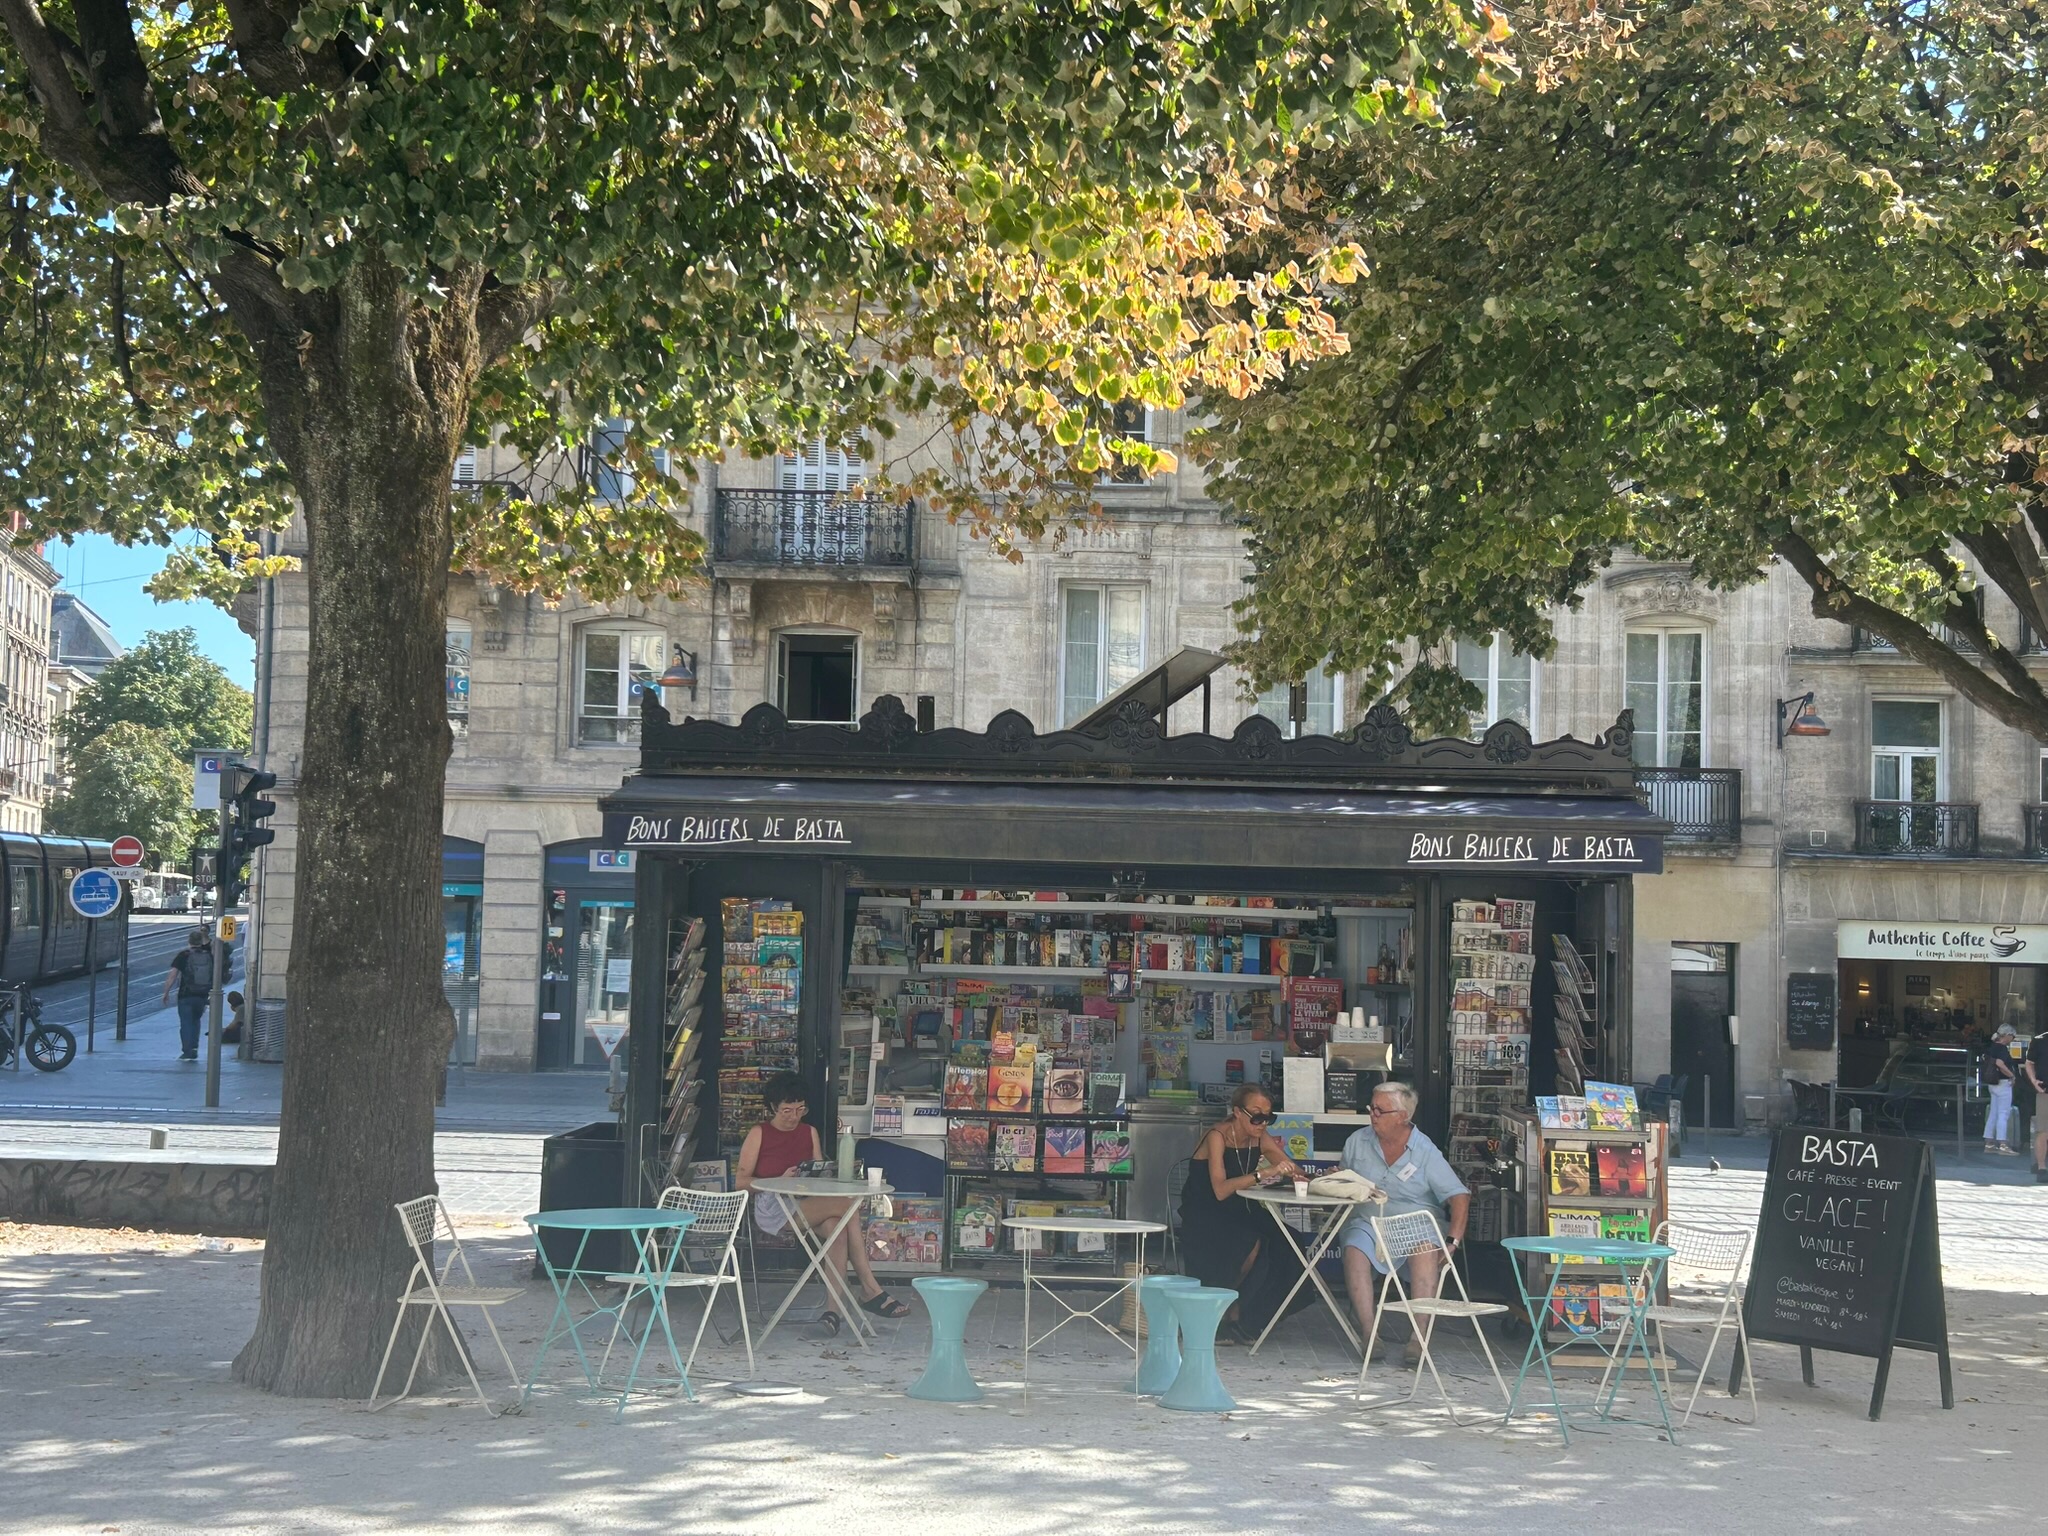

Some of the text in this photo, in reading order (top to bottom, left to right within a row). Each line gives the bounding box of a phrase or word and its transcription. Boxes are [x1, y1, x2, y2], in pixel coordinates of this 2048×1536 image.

[631, 684, 662, 695] CC
[627, 816, 844, 842] BONS BAISERS DE BASTA
[1410, 833, 1635, 859] BONS BAISERS DE BASTA
[600, 853, 628, 865] CIC
[223, 922, 234, 936] 15
[1868, 929, 1986, 947] Authentic Coffee
[1801, 1135, 1879, 1168] BASTA
[1787, 1168, 1816, 1183] CAFÉ
[1824, 1173, 1858, 1188] PRESSE
[1867, 1178, 1902, 1191] EVENT
[1783, 1192, 1873, 1230] GLACE
[1800, 1234, 1856, 1258] VANILLE
[1816, 1257, 1855, 1273] VEGAN
